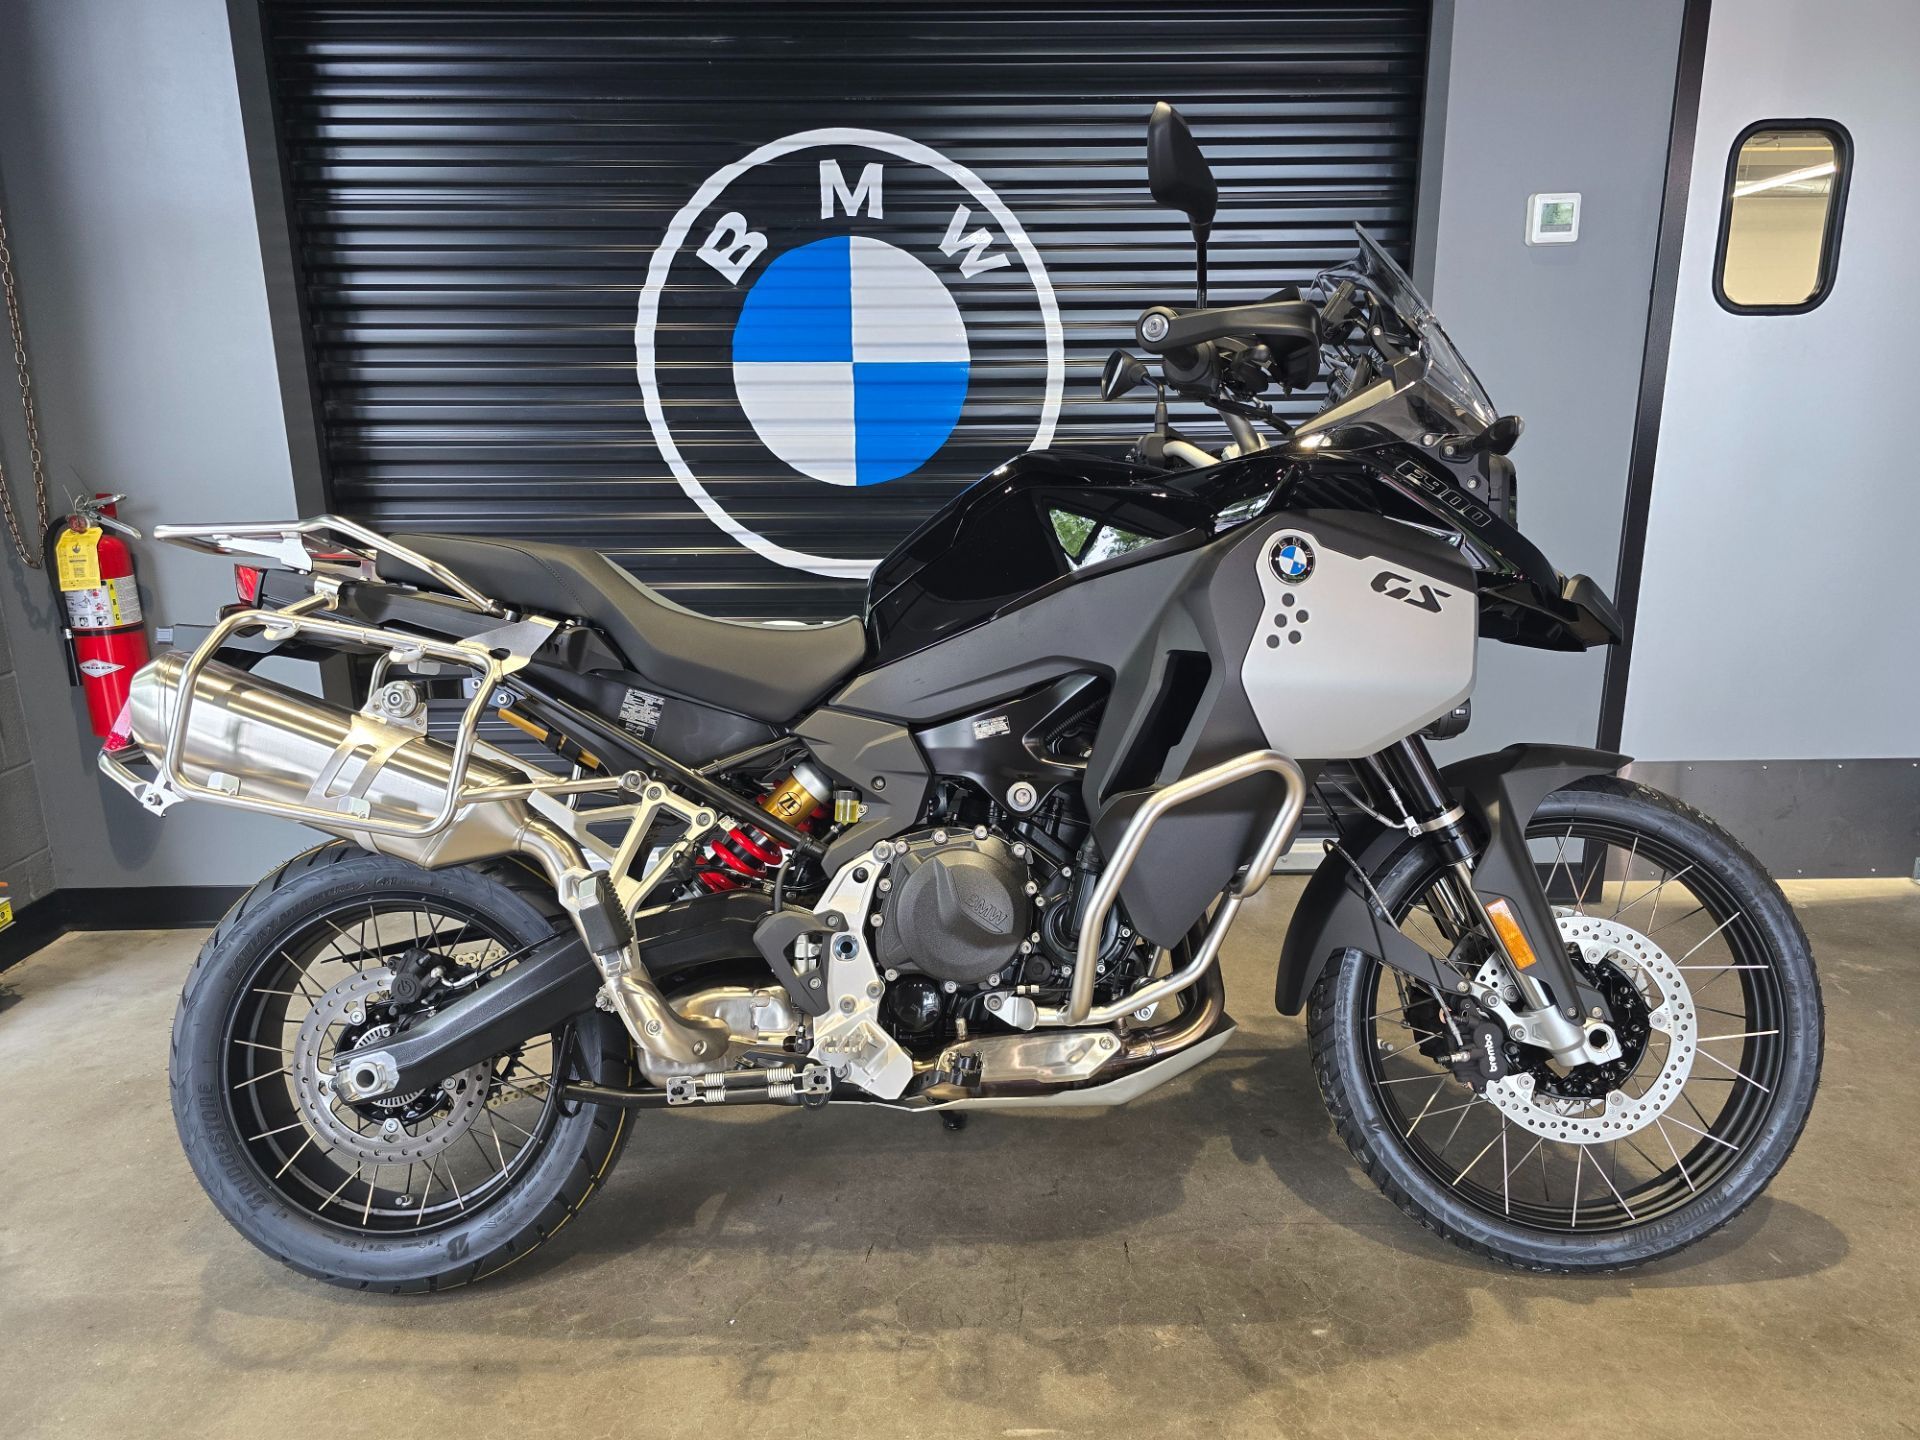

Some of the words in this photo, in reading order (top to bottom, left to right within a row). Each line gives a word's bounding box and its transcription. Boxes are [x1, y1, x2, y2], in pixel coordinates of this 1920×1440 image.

[695, 158, 1012, 287] BMW
[1370, 570, 1452, 614] GS
[963, 893, 1008, 926] BMW
[1484, 1033, 1498, 1073] brembo
[198, 1083, 273, 1212] BRIDGESTONE
